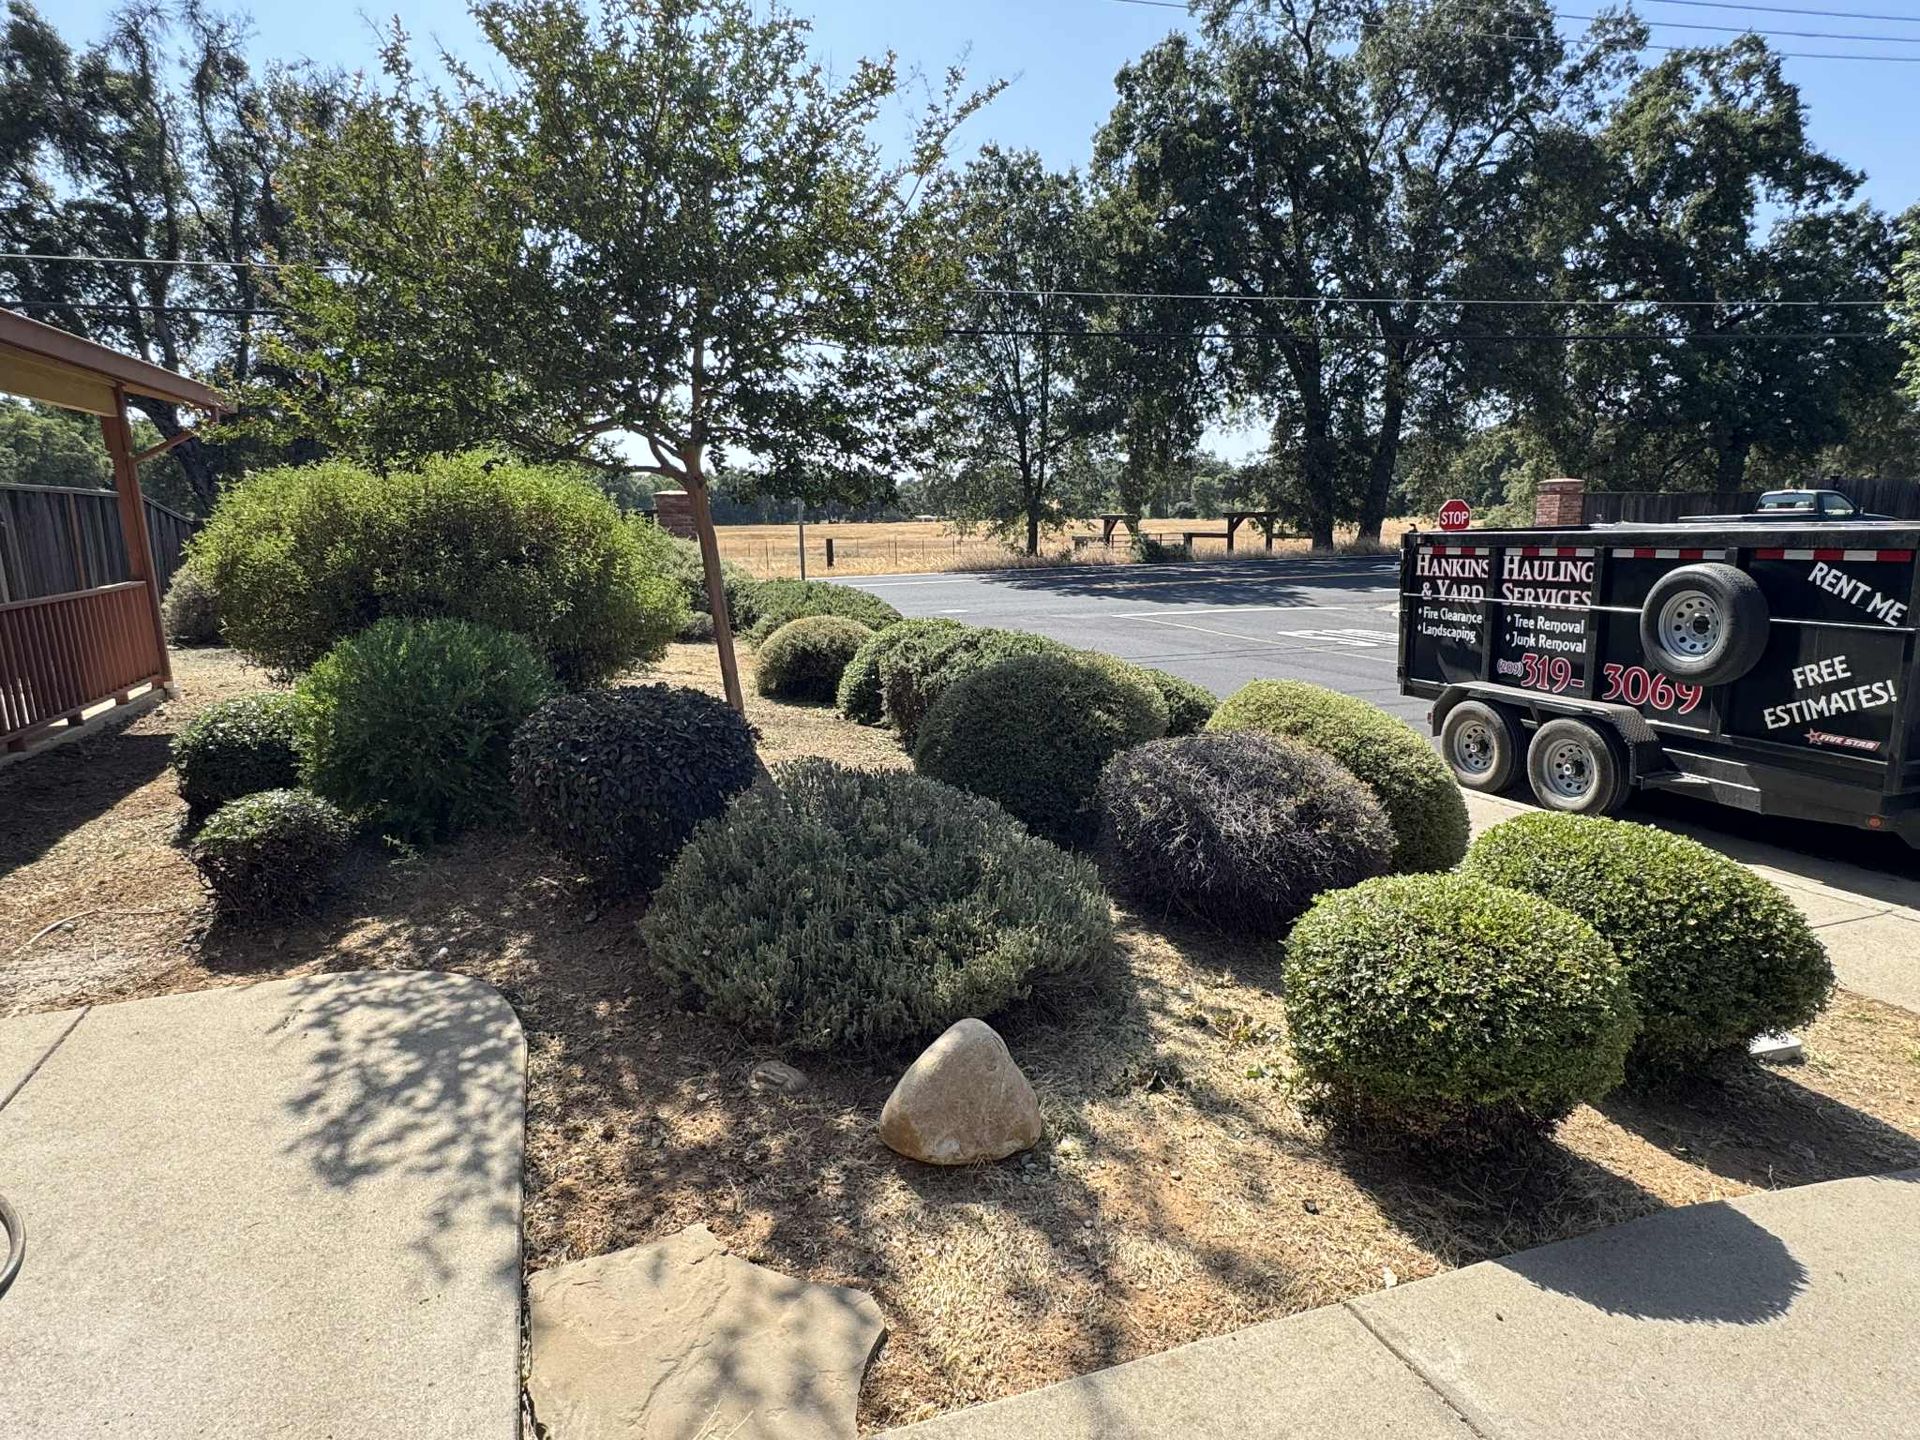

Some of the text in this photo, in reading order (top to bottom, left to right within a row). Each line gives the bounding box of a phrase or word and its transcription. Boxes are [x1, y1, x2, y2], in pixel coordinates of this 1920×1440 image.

[1441, 511, 1469, 525] STOP
[1416, 554, 1594, 583] HANKINS HAULING
[1421, 582, 1432, 600] &
[1808, 562, 1908, 626] RENT ME
[1423, 606, 1483, 624] Fire Clearance
[1514, 614, 1585, 634] Tree Removal
[1422, 622, 1476, 643] Landscaping
[1511, 631, 1587, 653] Junk Removal
[1792, 655, 1852, 689] FREE
[1602, 663, 1703, 714] 3069
[1763, 679, 1898, 729] ESTIMATES!
[1819, 734, 1845, 744] FIVE
